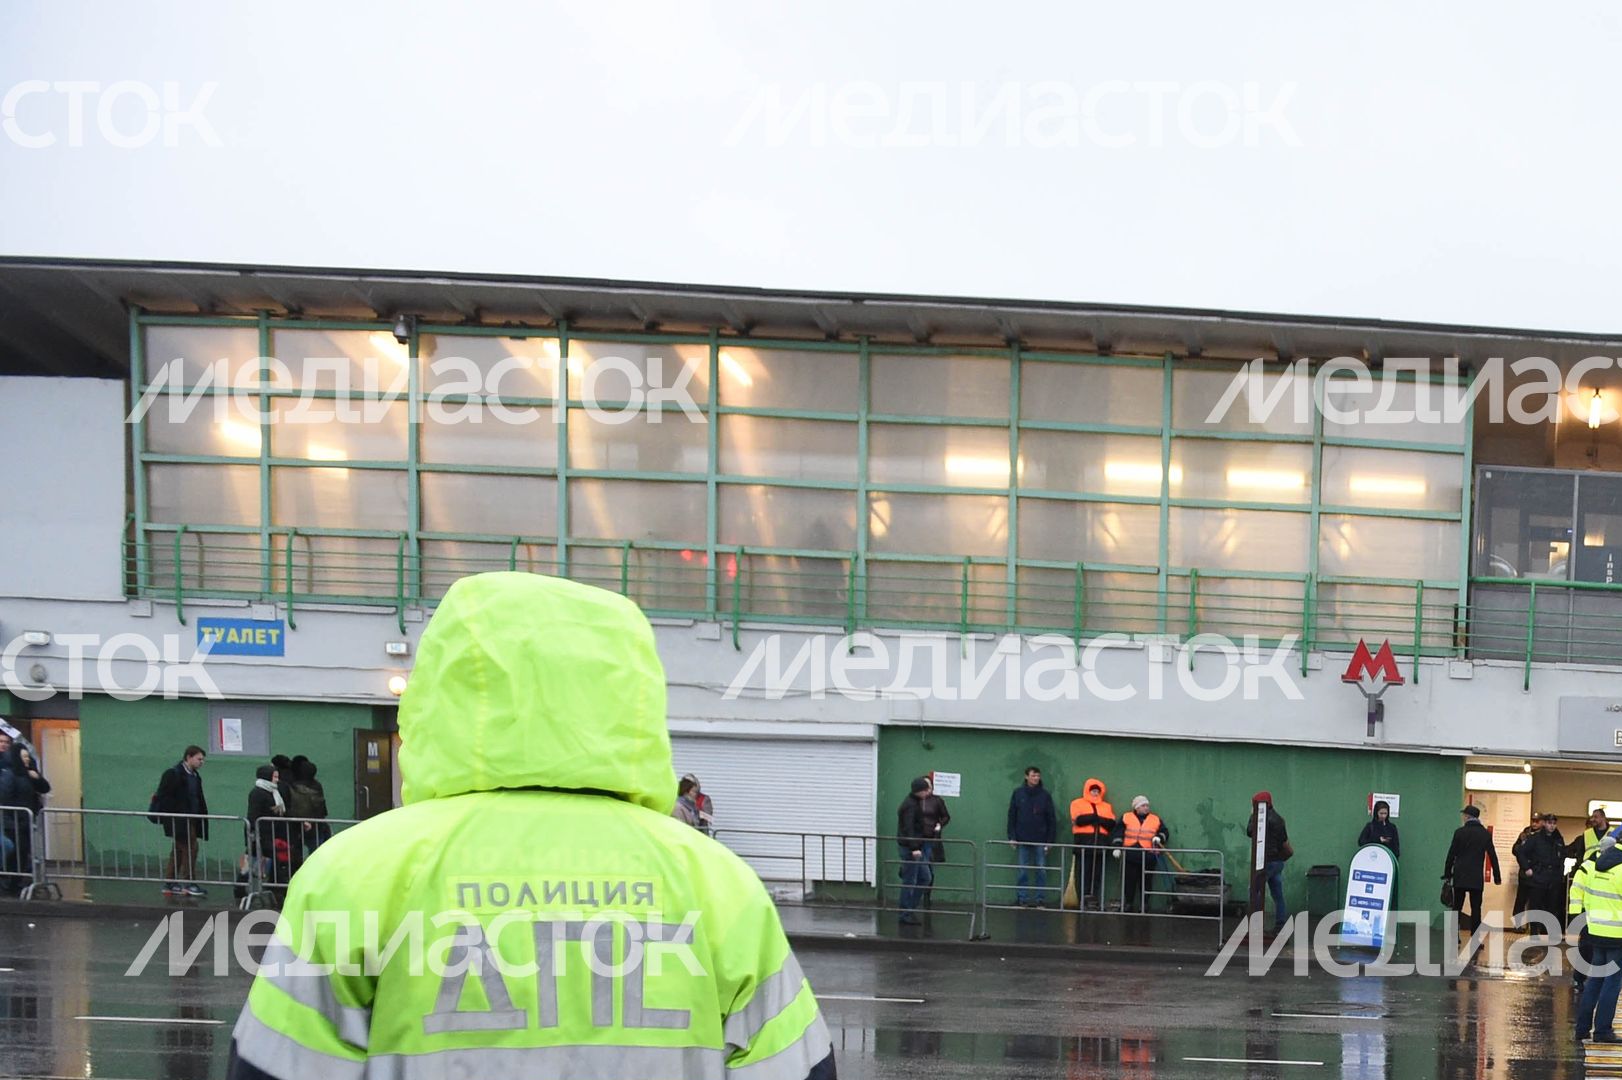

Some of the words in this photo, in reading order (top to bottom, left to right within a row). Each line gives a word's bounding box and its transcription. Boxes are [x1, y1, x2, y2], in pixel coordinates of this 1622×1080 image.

[201, 627, 280, 644] ТУАЛЕТ
[456, 880, 655, 908] ПОЛИЦИЯ
[422, 919, 694, 1035] ДПС
